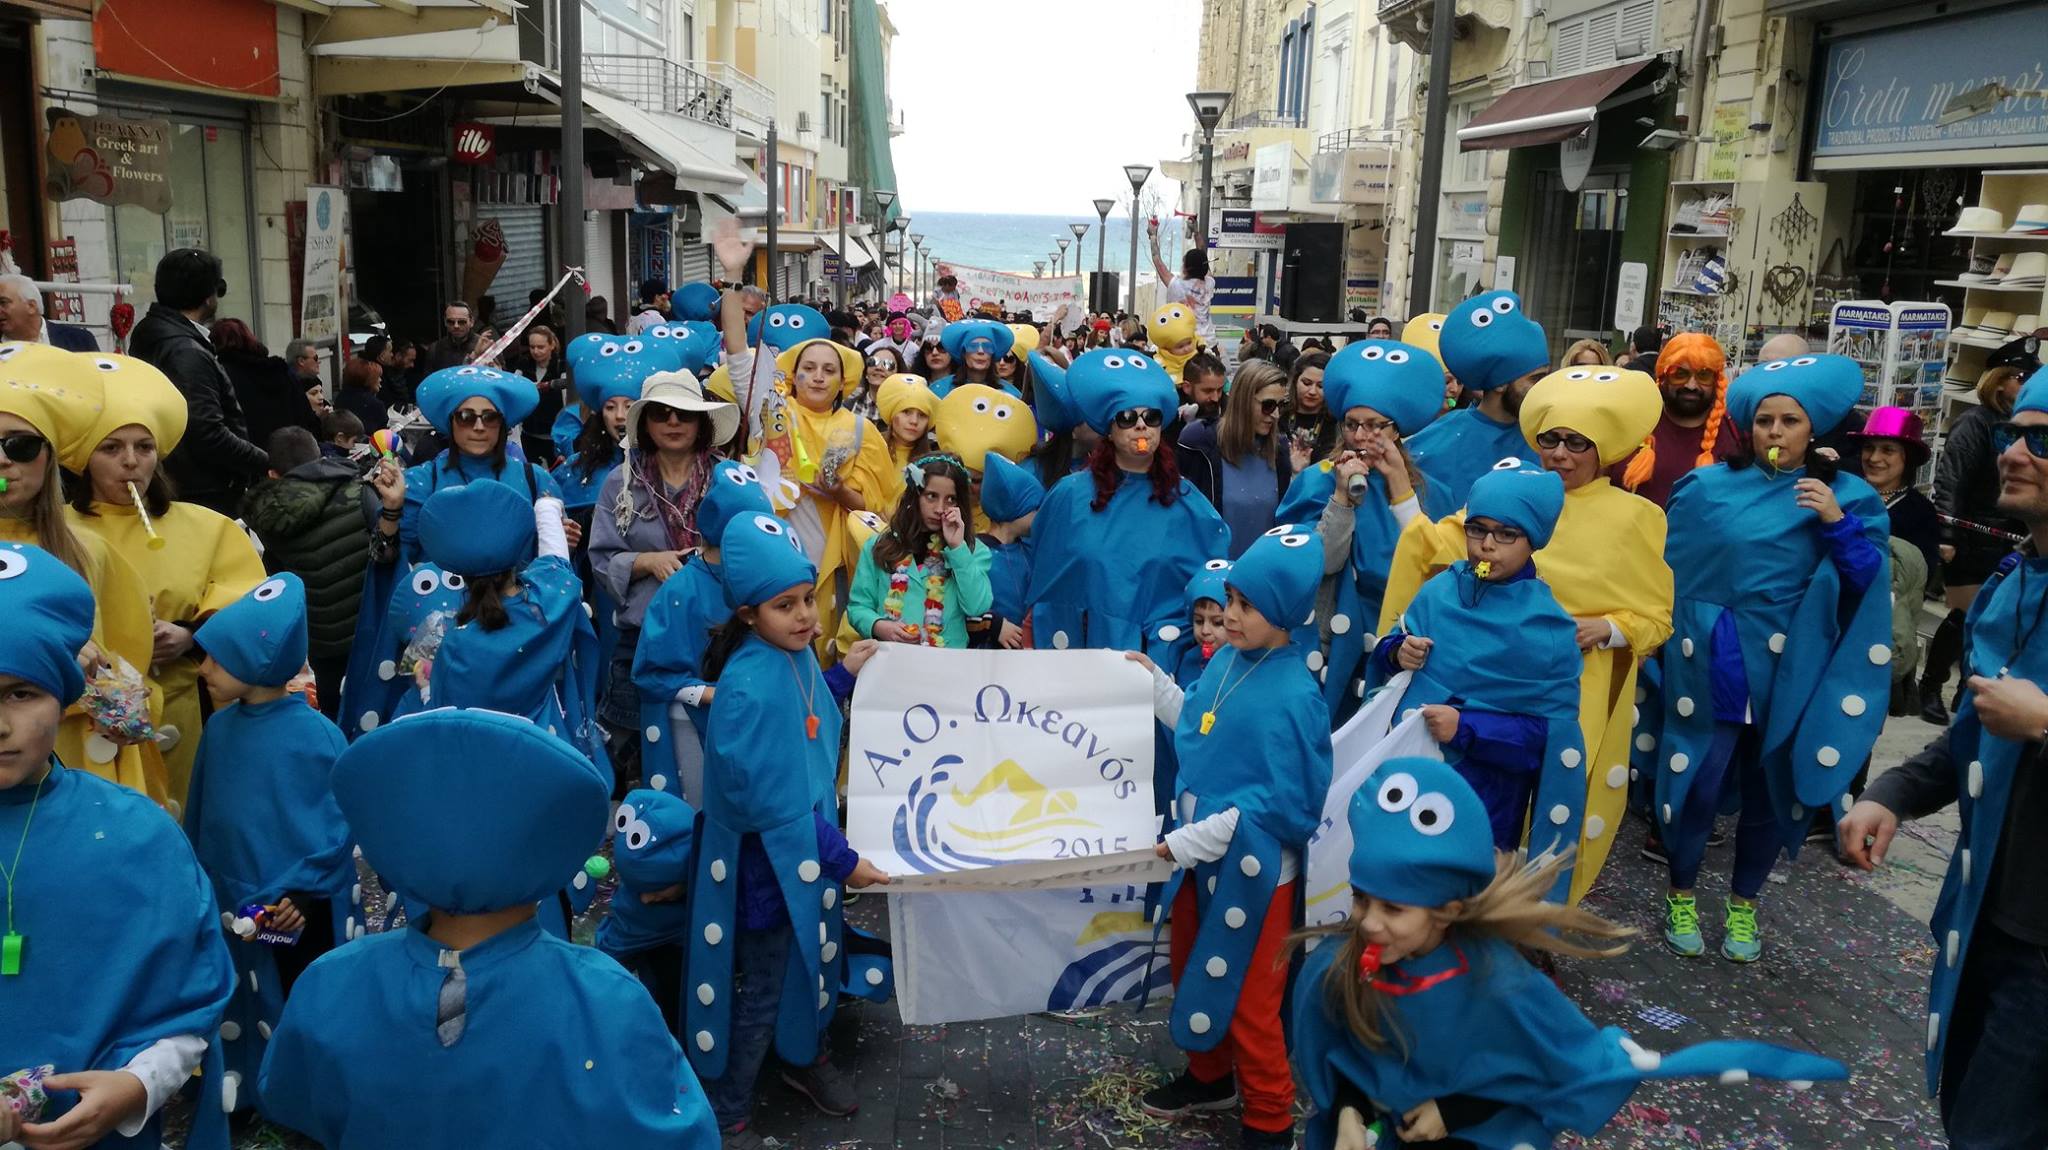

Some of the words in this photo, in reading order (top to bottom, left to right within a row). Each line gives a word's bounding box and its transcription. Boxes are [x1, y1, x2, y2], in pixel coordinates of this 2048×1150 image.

[1827, 47, 1911, 128] Creta
[458, 129, 491, 159] illy
[1828, 131, 1865, 146] TRADITIONAL
[1866, 127, 1900, 144] PRODUCTS
[96, 136, 136, 153] Greek
[139, 143, 159, 155] art
[120, 152, 133, 165] &
[1714, 151, 1737, 163] Honey
[112, 165, 163, 182] Flowers
[1713, 168, 1736, 180] Herbs
[1367, 182, 1394, 190] AEGEN
[1838, 309, 1891, 321] MARMATAKIS
[1900, 311, 1947, 322] MARMATAKIS
[974, 684, 1137, 800] Ωκεανός
[1051, 836, 1129, 859] 2015
